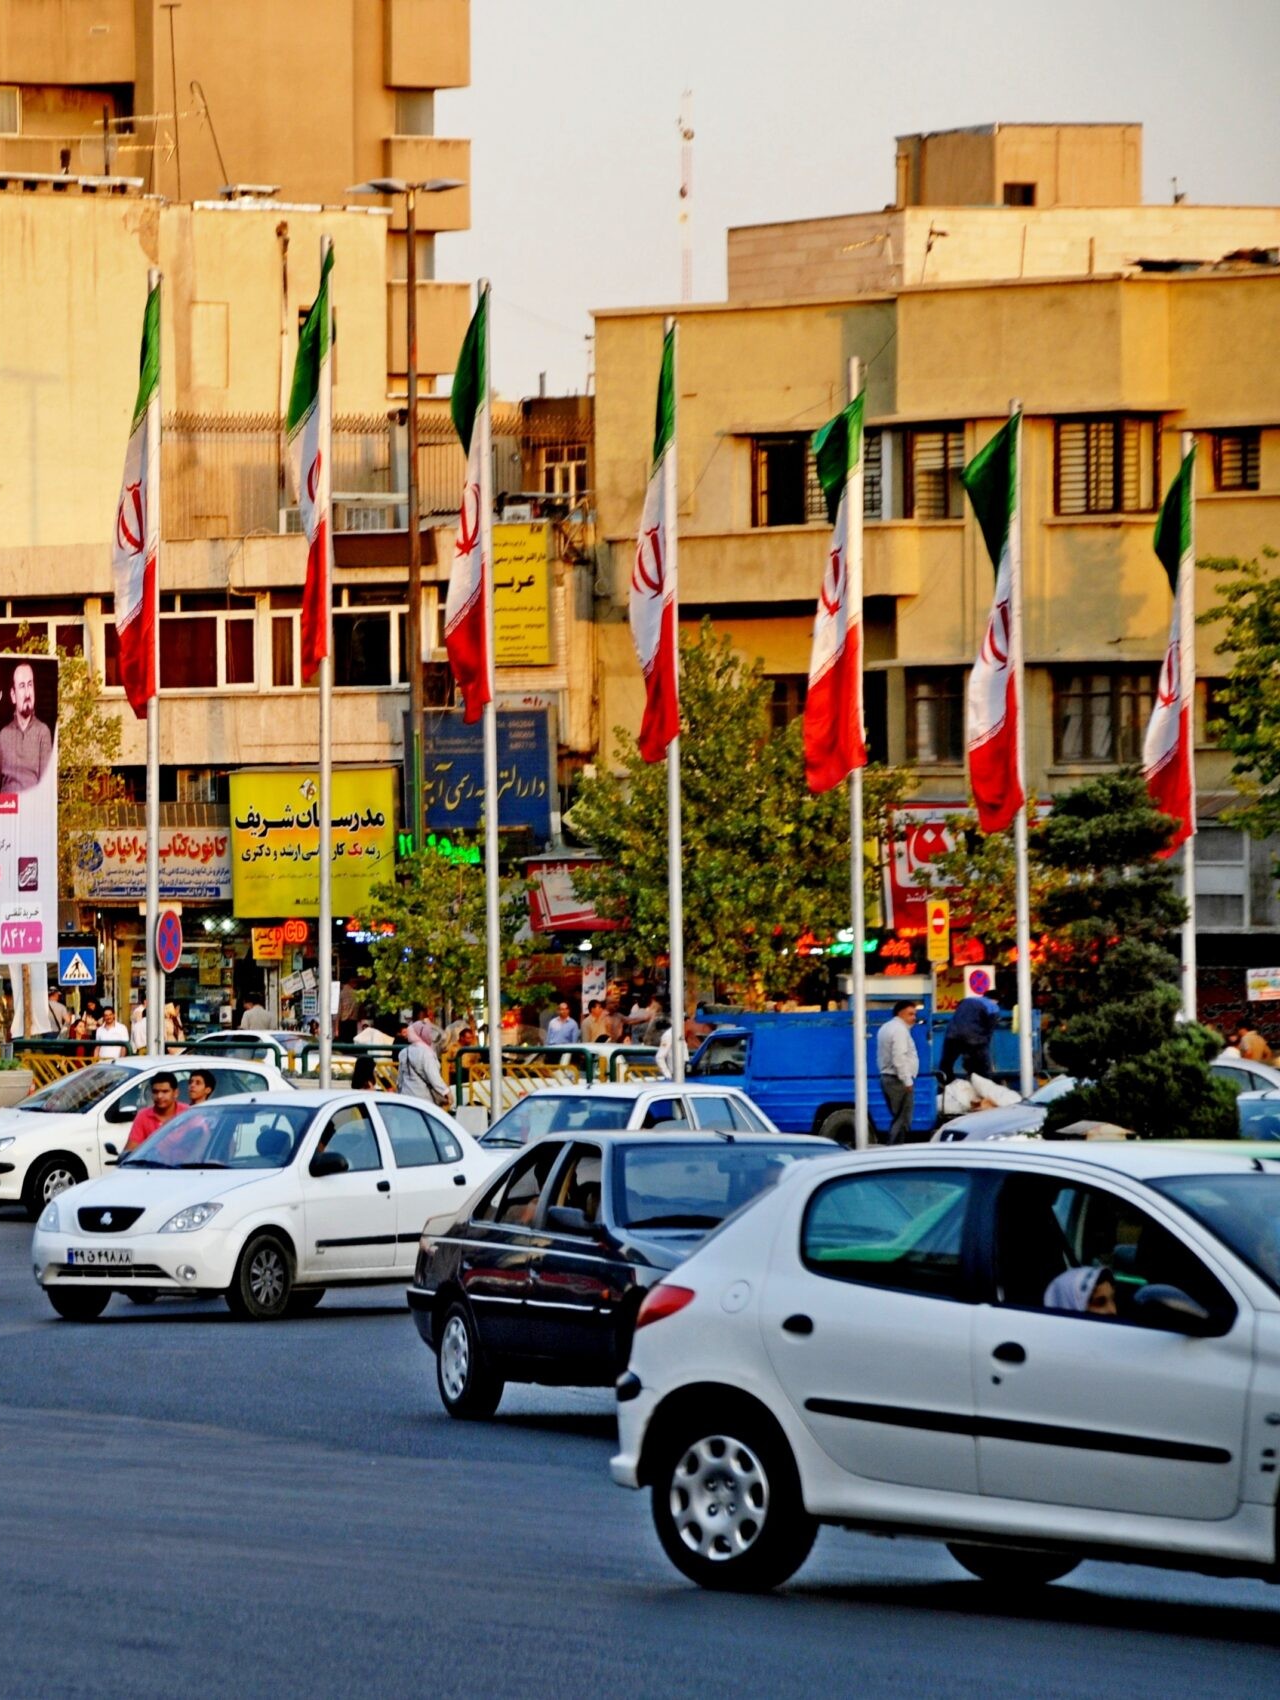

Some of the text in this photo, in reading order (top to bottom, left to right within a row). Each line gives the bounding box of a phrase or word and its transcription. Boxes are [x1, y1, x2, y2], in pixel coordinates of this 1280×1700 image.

[235, 802, 385, 838] مدرسان شریف
[158, 832, 189, 864] کتاب
[187, 835, 228, 864] کانون
[241, 844, 271, 862] دکتری
[280, 844, 301, 862] ارشد
[22, 907, 39, 920] خرید
[2, 927, 41, 949] ۸۴۲۰۰
[280, 921, 307, 942] CD
